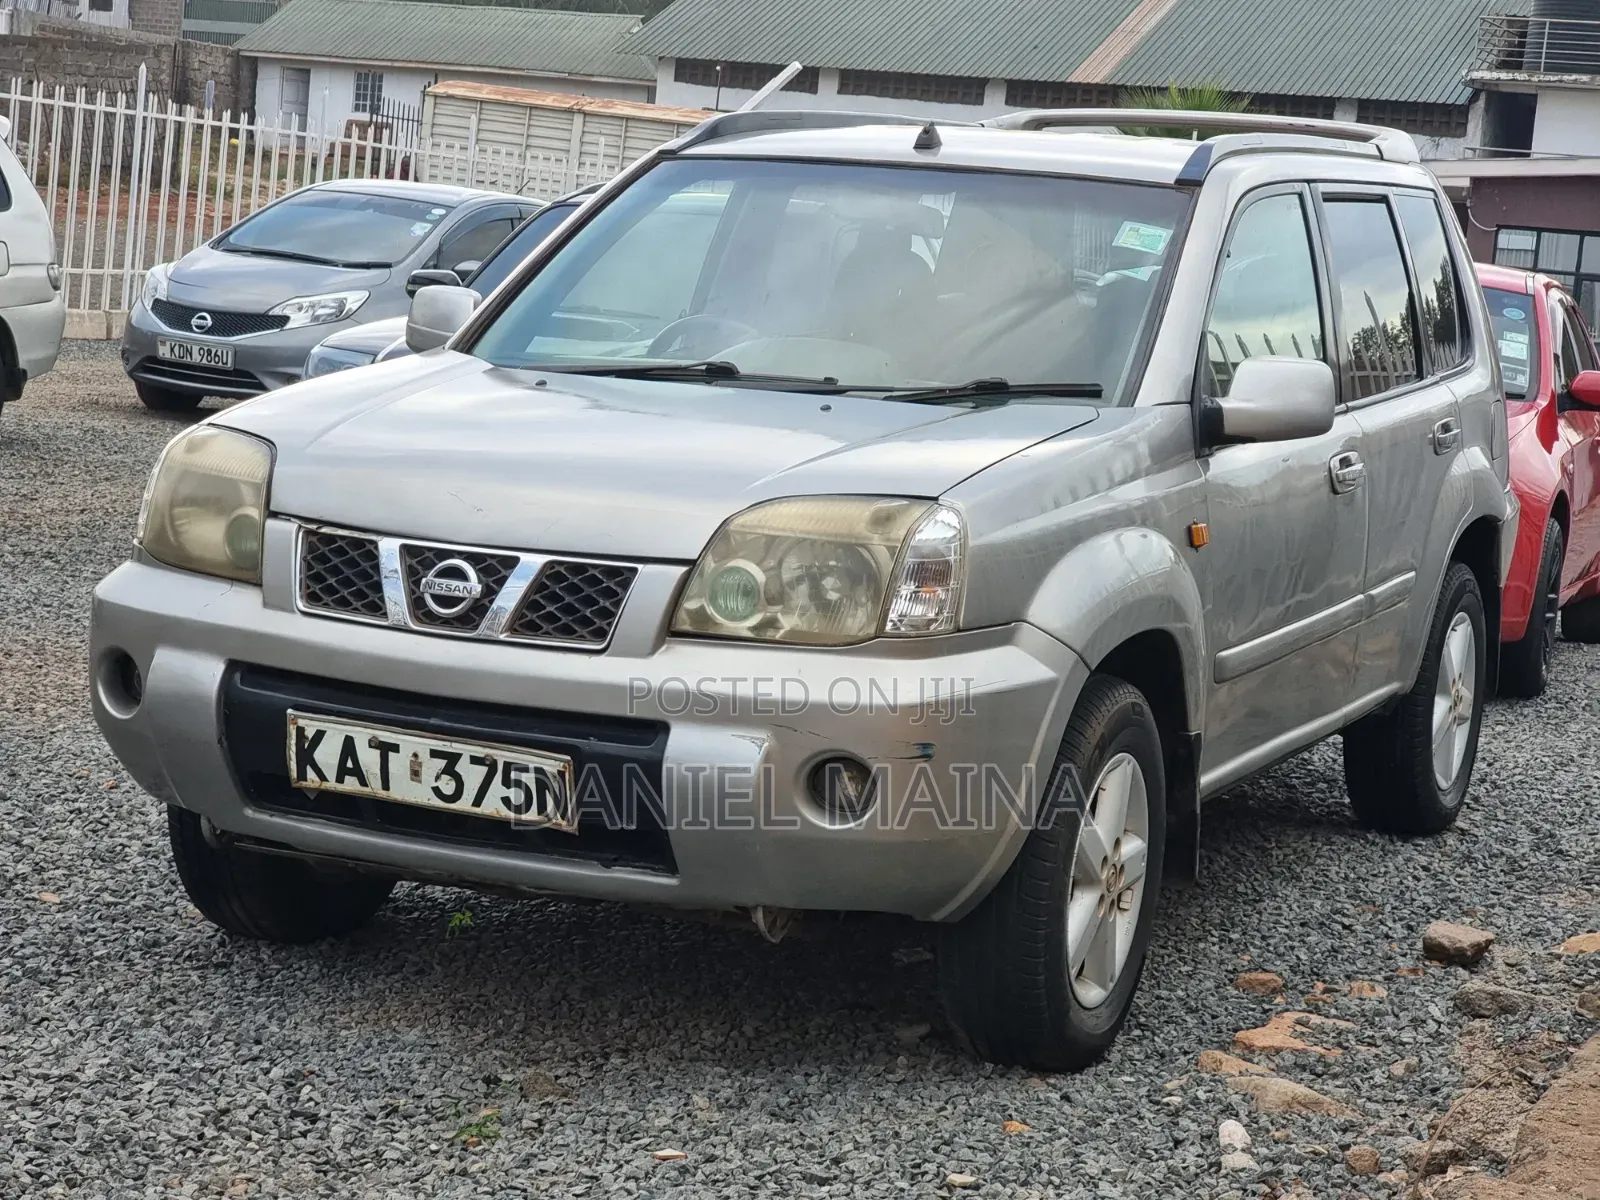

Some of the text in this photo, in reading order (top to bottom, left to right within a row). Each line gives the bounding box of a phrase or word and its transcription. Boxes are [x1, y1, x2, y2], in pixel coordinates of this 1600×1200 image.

[169, 342, 229, 366] KDN 986U
[424, 581, 473, 595] NISSAN
[296, 726, 567, 820] KAT 375N
